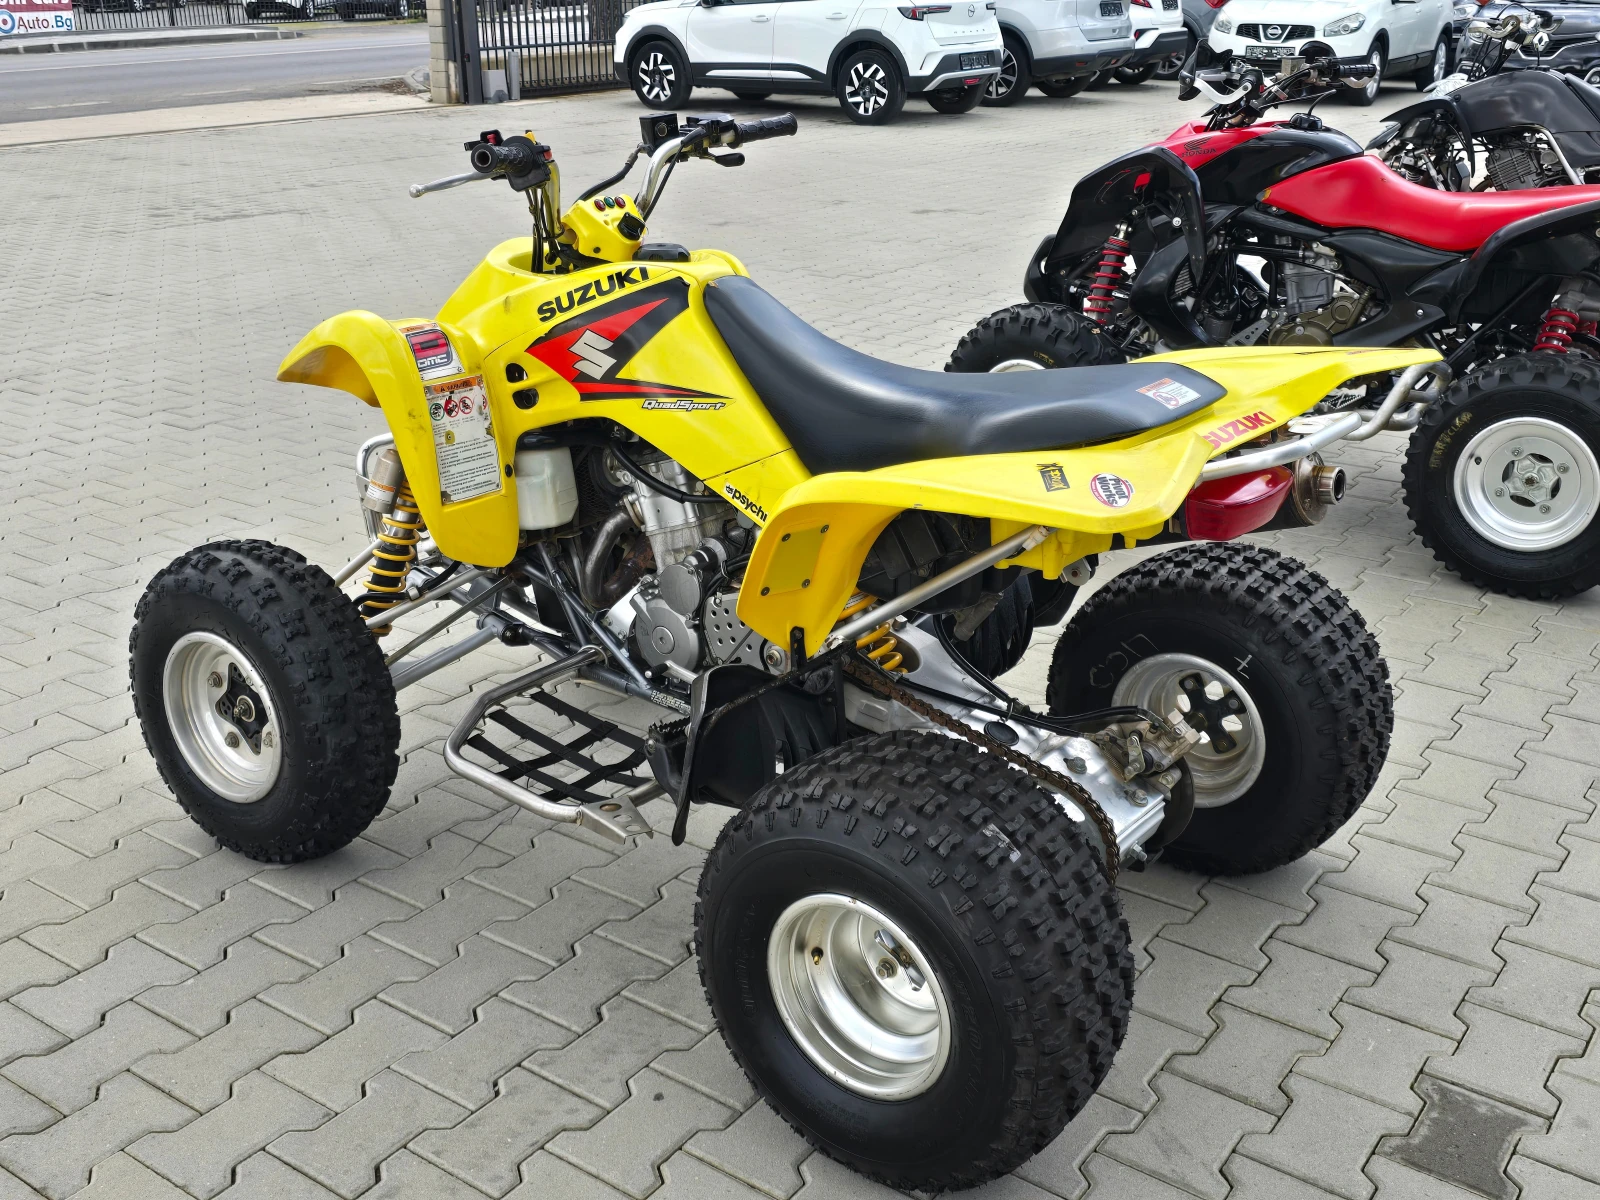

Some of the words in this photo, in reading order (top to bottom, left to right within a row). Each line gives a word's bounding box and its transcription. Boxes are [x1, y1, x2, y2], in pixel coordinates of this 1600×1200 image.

[1182, 148, 1217, 157] HONDA
[537, 266, 650, 323] SUZUKI
[641, 398, 727, 412] QuadSport
[1202, 410, 1277, 451] SUZUKI
[1096, 476, 1118, 505] Works
[1108, 478, 1129, 500] Pivot
